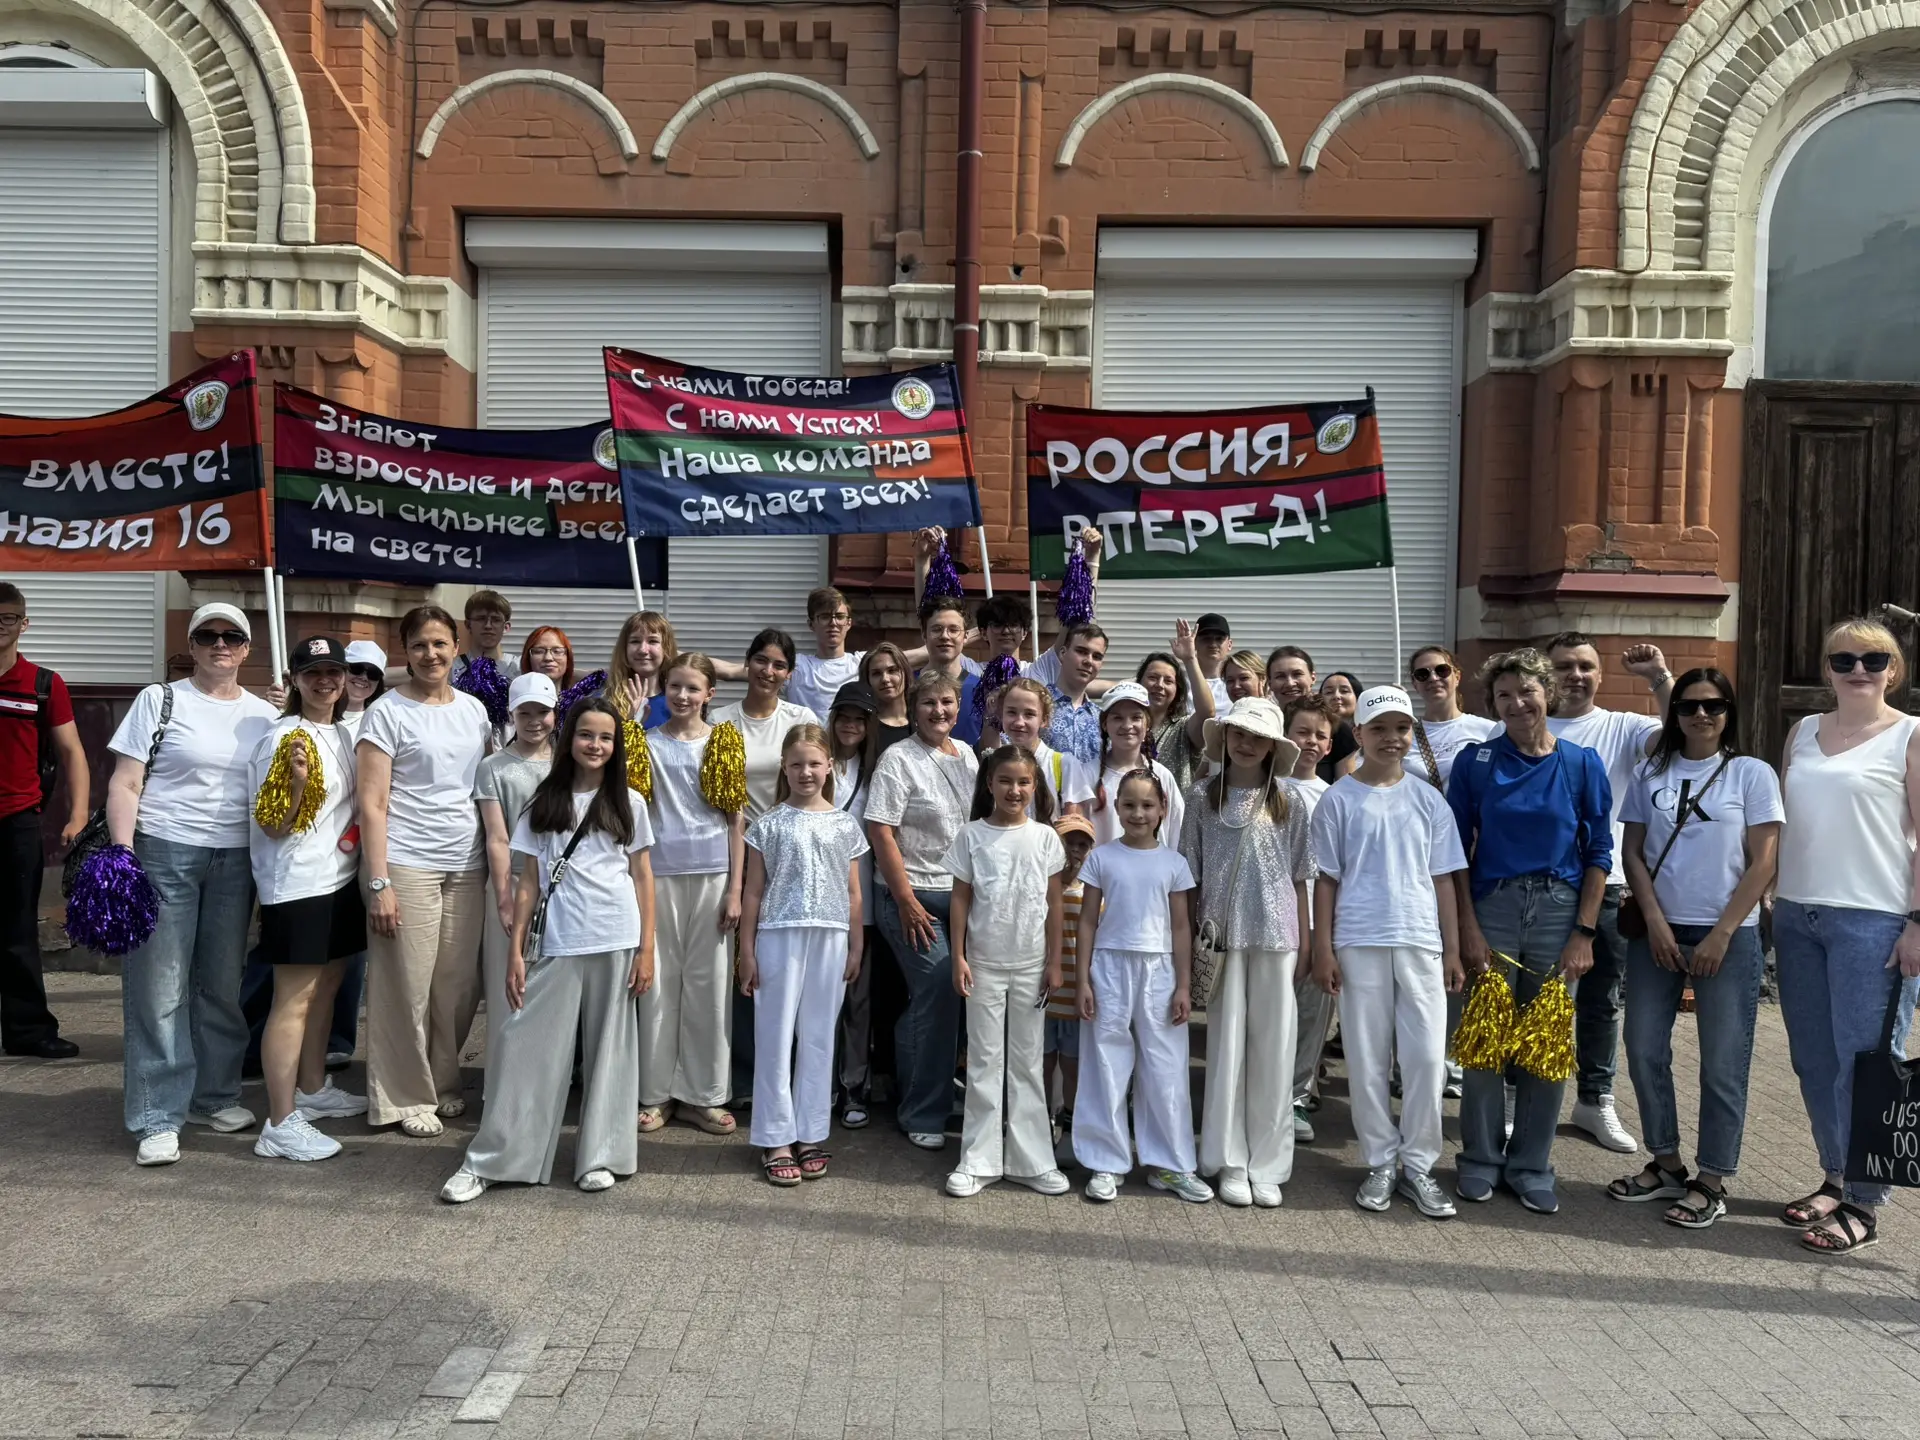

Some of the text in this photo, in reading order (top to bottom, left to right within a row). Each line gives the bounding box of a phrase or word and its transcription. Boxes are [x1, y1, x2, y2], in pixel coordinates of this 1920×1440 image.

[630, 368, 851, 399] С нами Победа!
[315, 403, 437, 453] Знают
[666, 403, 883, 436] С нами Успех!
[314, 446, 622, 506] взрослые и дети
[657, 446, 764, 480] Наша
[773, 439, 931, 474] команда
[1046, 422, 1307, 489] РОССИЯ,
[311, 483, 384, 519] Мы
[399, 503, 546, 537] сильнее
[680, 475, 933, 525] сделает всех!
[178, 502, 231, 548] 16
[310, 527, 482, 569] на свете!
[1366, 694, 1408, 707] adidas
[1882, 1101, 1920, 1128] JUS
[1866, 1152, 1896, 1180] MY
